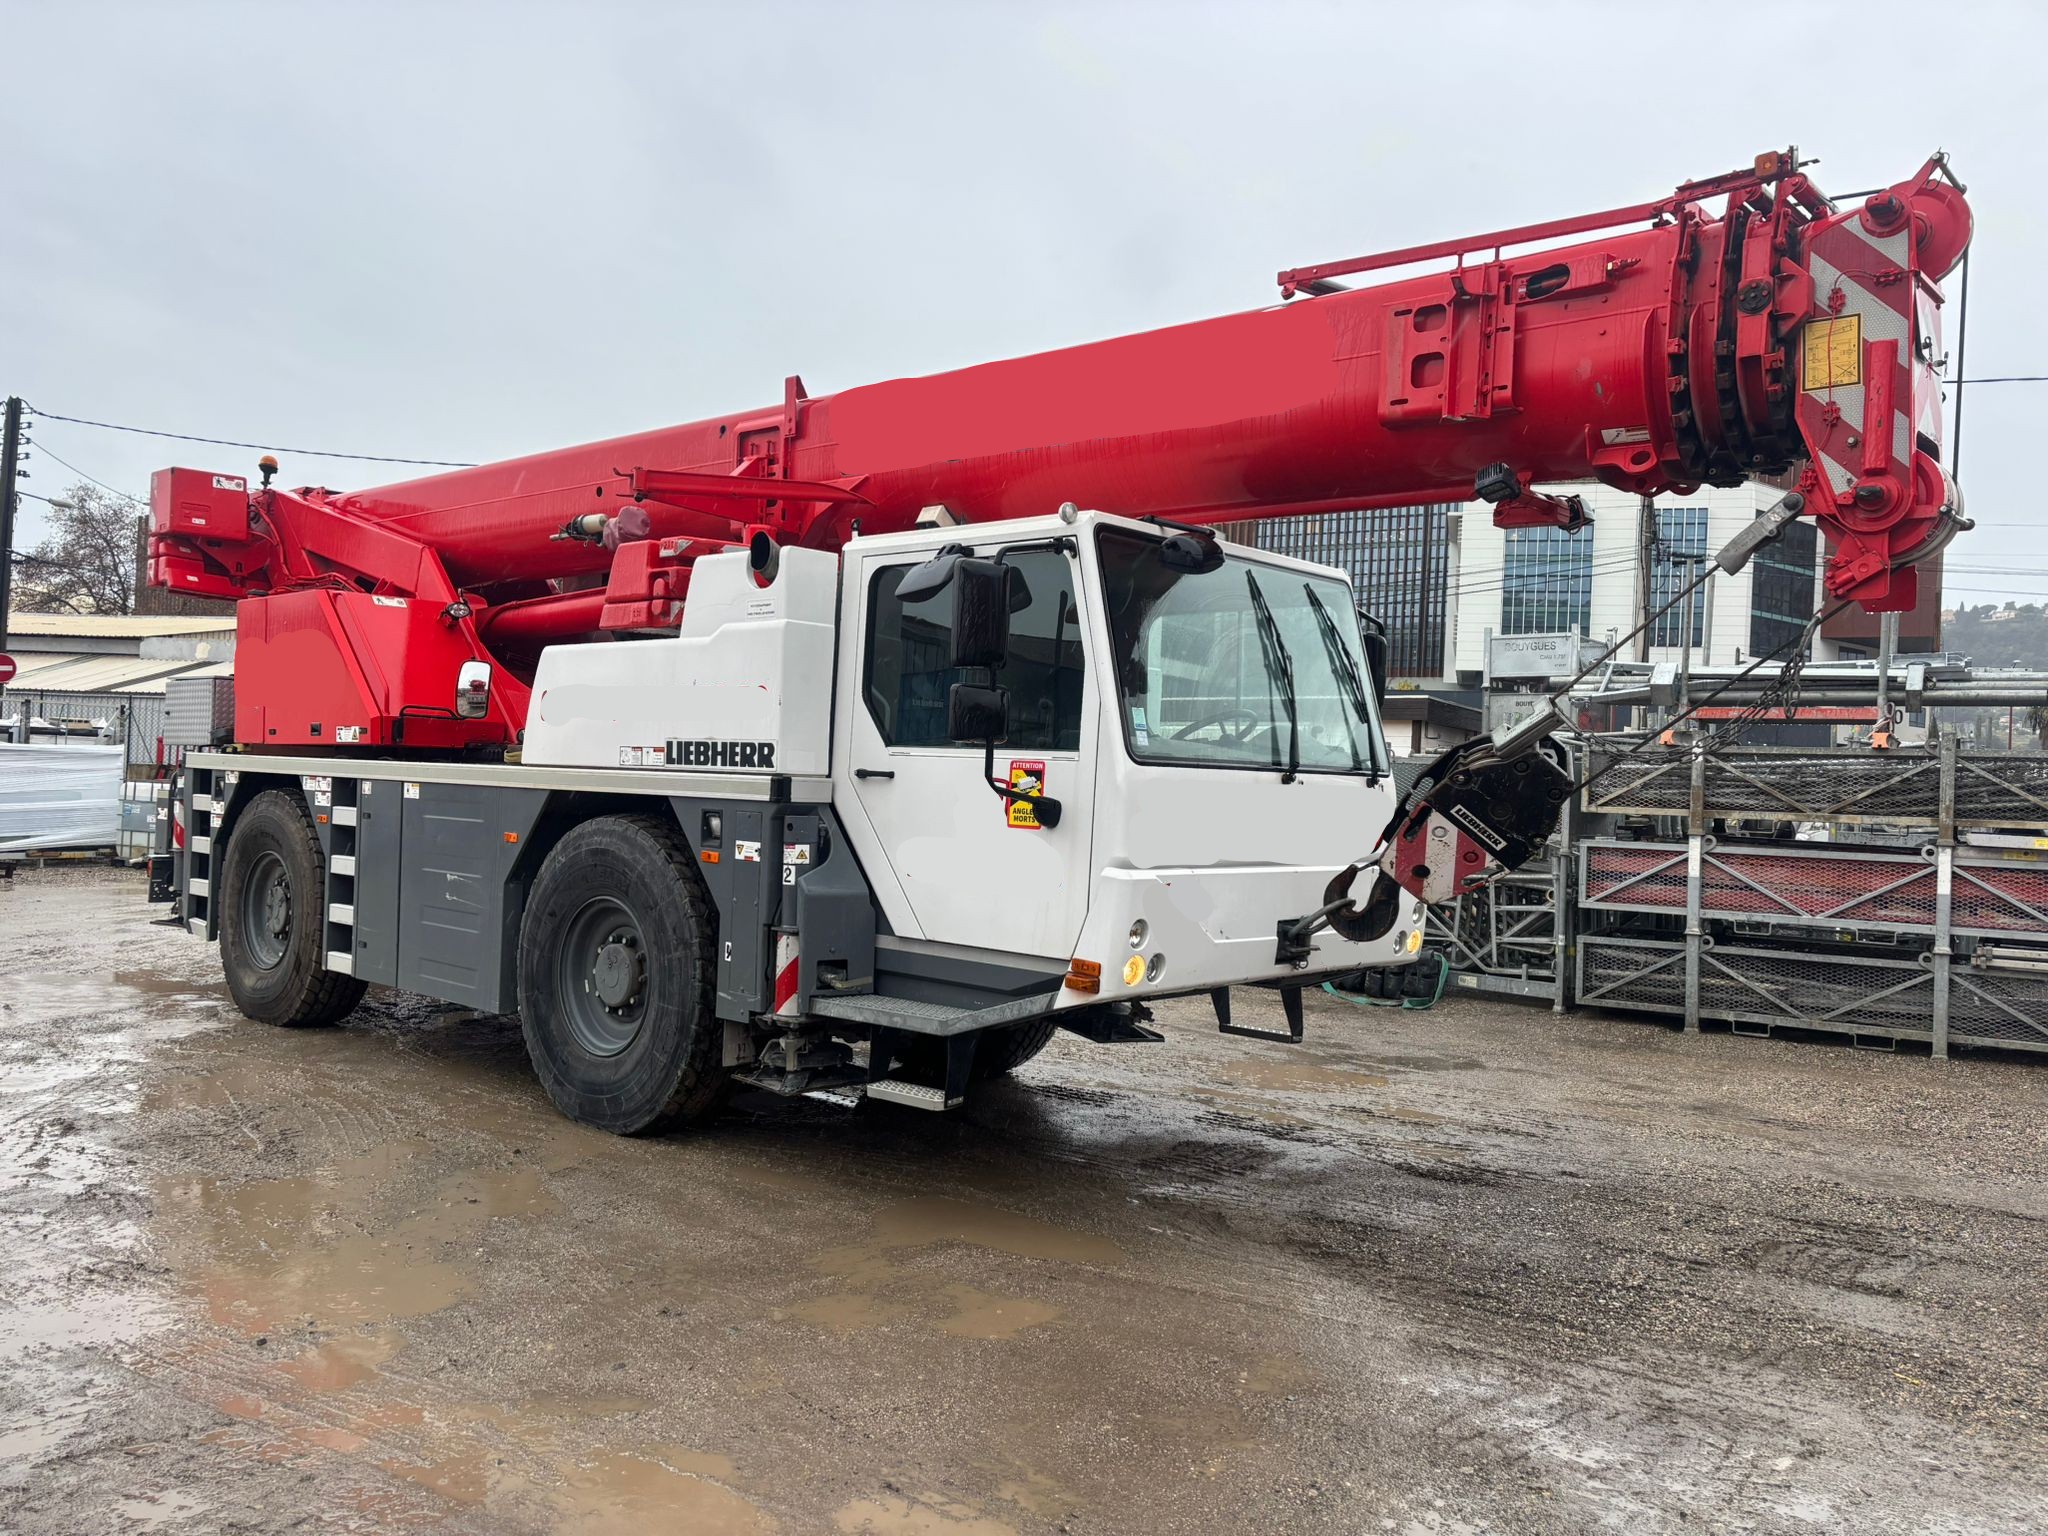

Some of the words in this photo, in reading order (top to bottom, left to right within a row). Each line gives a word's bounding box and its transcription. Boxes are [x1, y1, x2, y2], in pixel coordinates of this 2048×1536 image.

[1504, 641, 1556, 651] BOUYGUES
[666, 741, 775, 768] LIEBHERR
[1014, 815, 1036, 823] MORTS
[1454, 808, 1502, 847] LIEBHERR
[783, 867, 792, 883] 2
